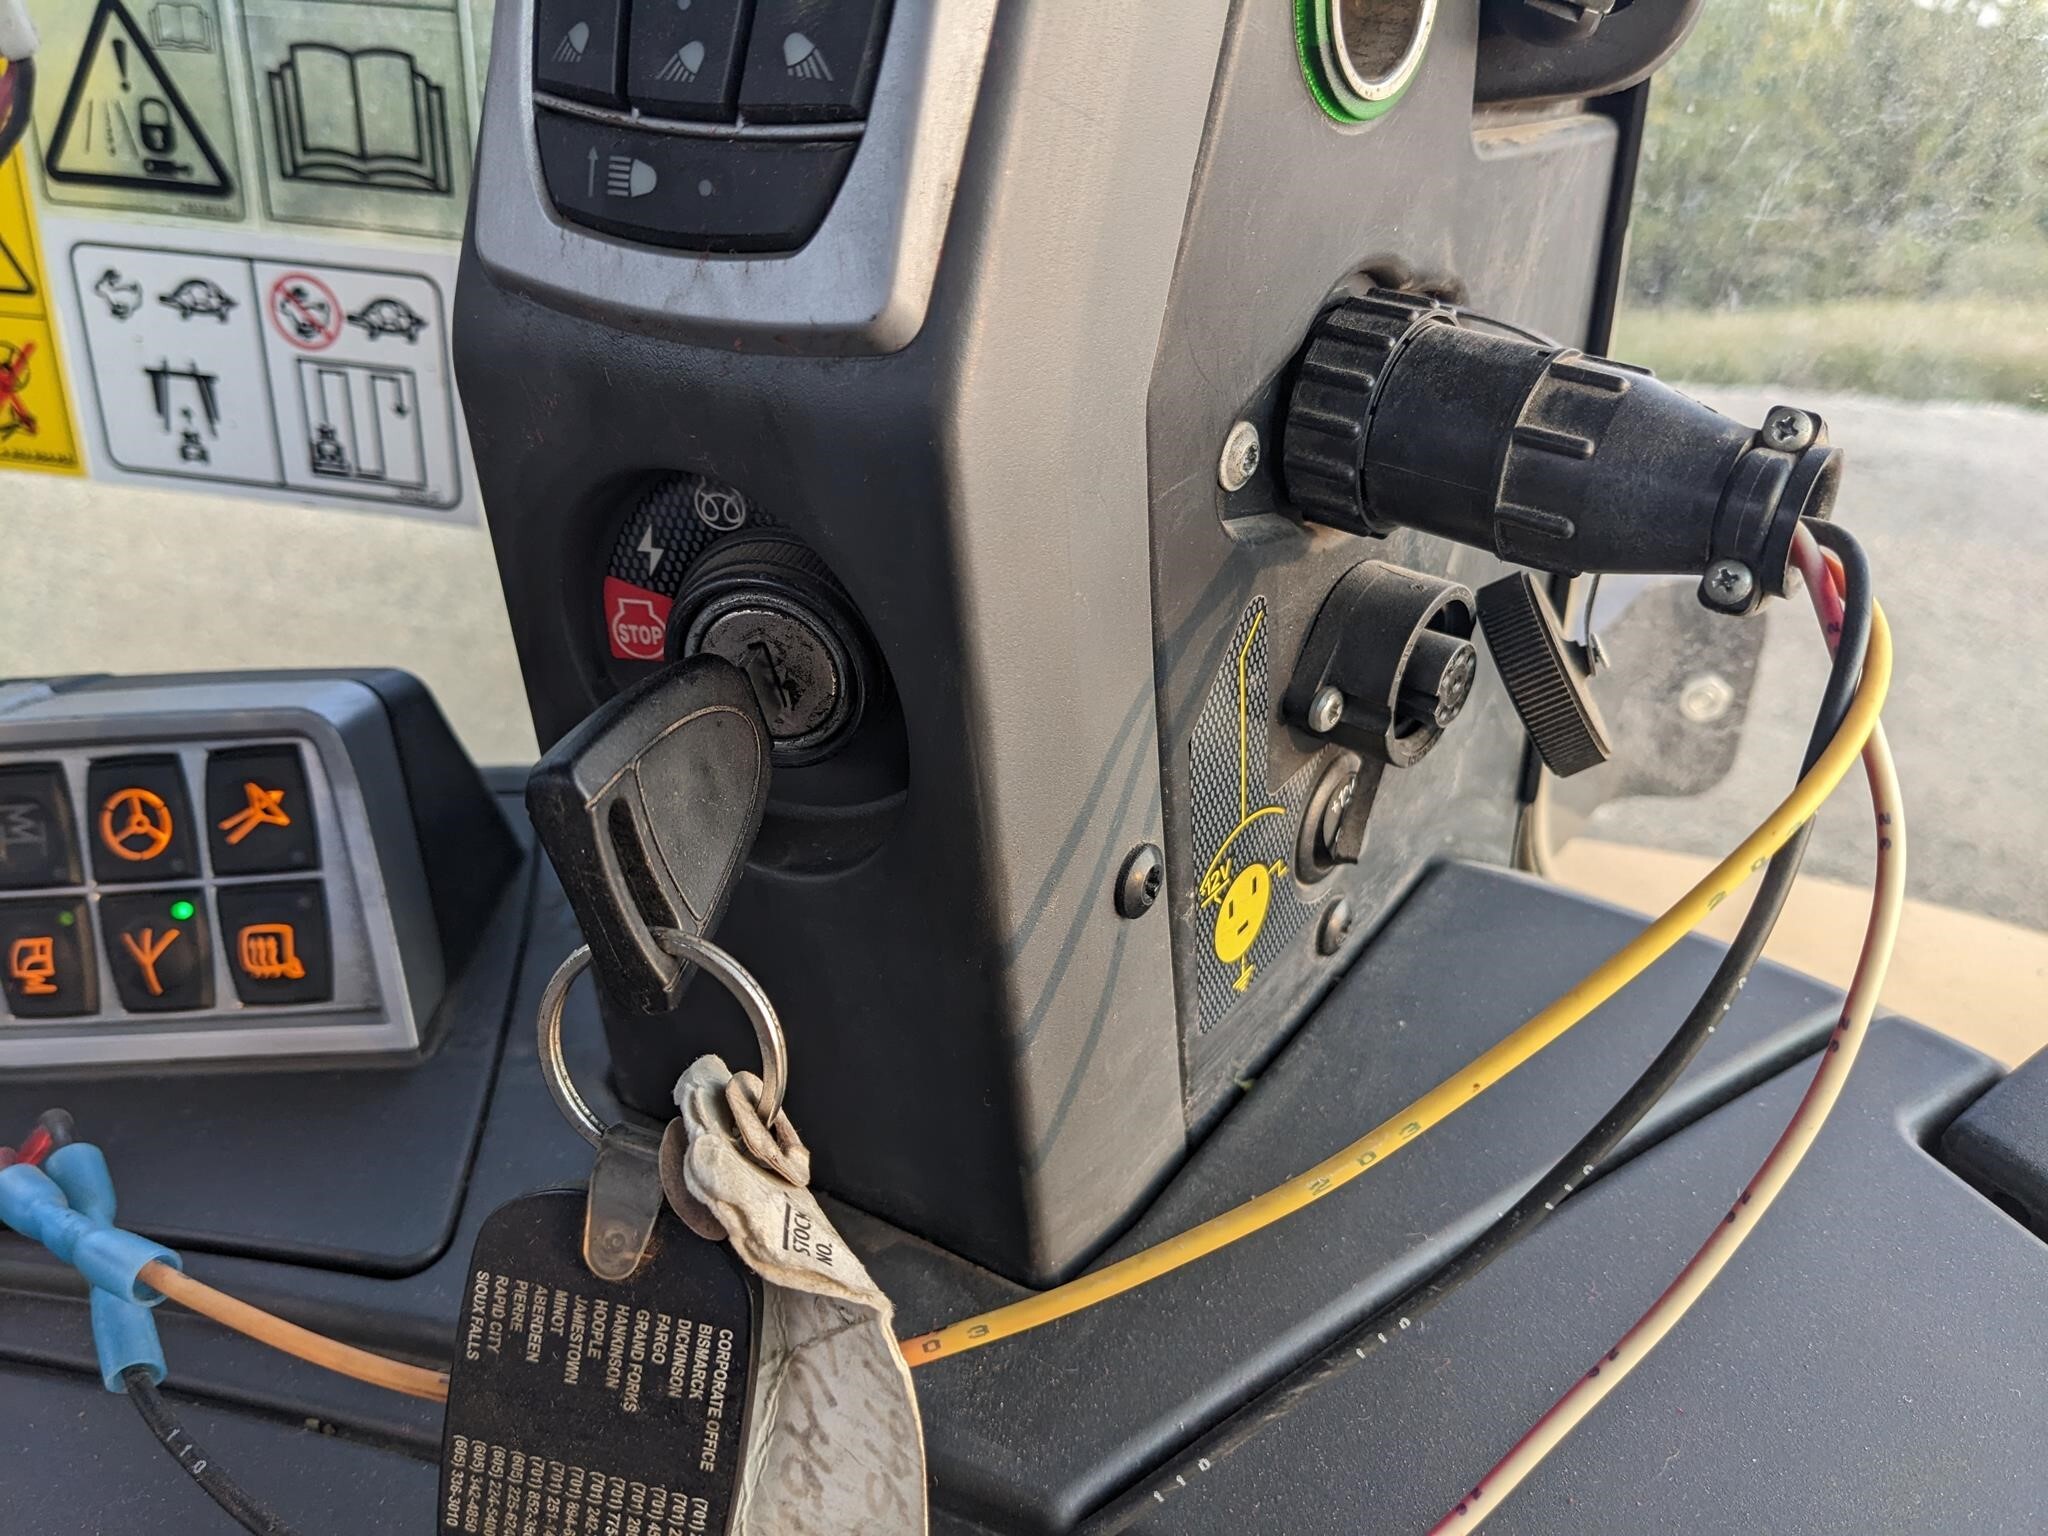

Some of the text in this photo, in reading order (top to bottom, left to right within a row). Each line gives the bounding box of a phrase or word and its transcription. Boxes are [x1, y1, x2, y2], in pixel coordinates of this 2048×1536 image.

[618, 624, 662, 645] STOP
[793, 1211, 811, 1256] STOCK
[816, 1243, 833, 1267] NO.
[509, 1280, 528, 1333] PIERRE
[525, 1284, 549, 1363] ABERDEEN
[550, 1289, 569, 1337] MINOT
[587, 1299, 609, 1360] HOOPLE
[564, 1294, 589, 1386] JAMESTOWN
[605, 1304, 630, 1389] HANKINSON
[633, 1309, 650, 1361] GRAND
[651, 1313, 671, 1365] FARGO
[668, 1318, 692, 1398] DICKINSON
[688, 1323, 713, 1400] BISMARCK
[707, 1328, 734, 1419] CORPORATE
[446, 1270, 490, 1527] SIOUX FALLS (605) 336-3010
[464, 1275, 509, 1533] RAPID CITY (605) 342-4850
[623, 1362, 644, 1414] FORKS
[488, 1445, 507, 1478] (605)
[507, 1450, 526, 1484] (605)
[700, 1420, 720, 1473] OFFICE
[526, 1455, 546, 1489] (701)
[546, 1460, 565, 1494] (701)
[565, 1466, 585, 1499] (701)
[586, 1471, 606, 1505] (701)
[606, 1476, 626, 1510] (701)
[626, 1481, 647, 1515] (701)
[646, 1487, 667, 1521] (701)
[667, 1492, 688, 1527] (701)
[688, 1497, 709, 1532] (701)
